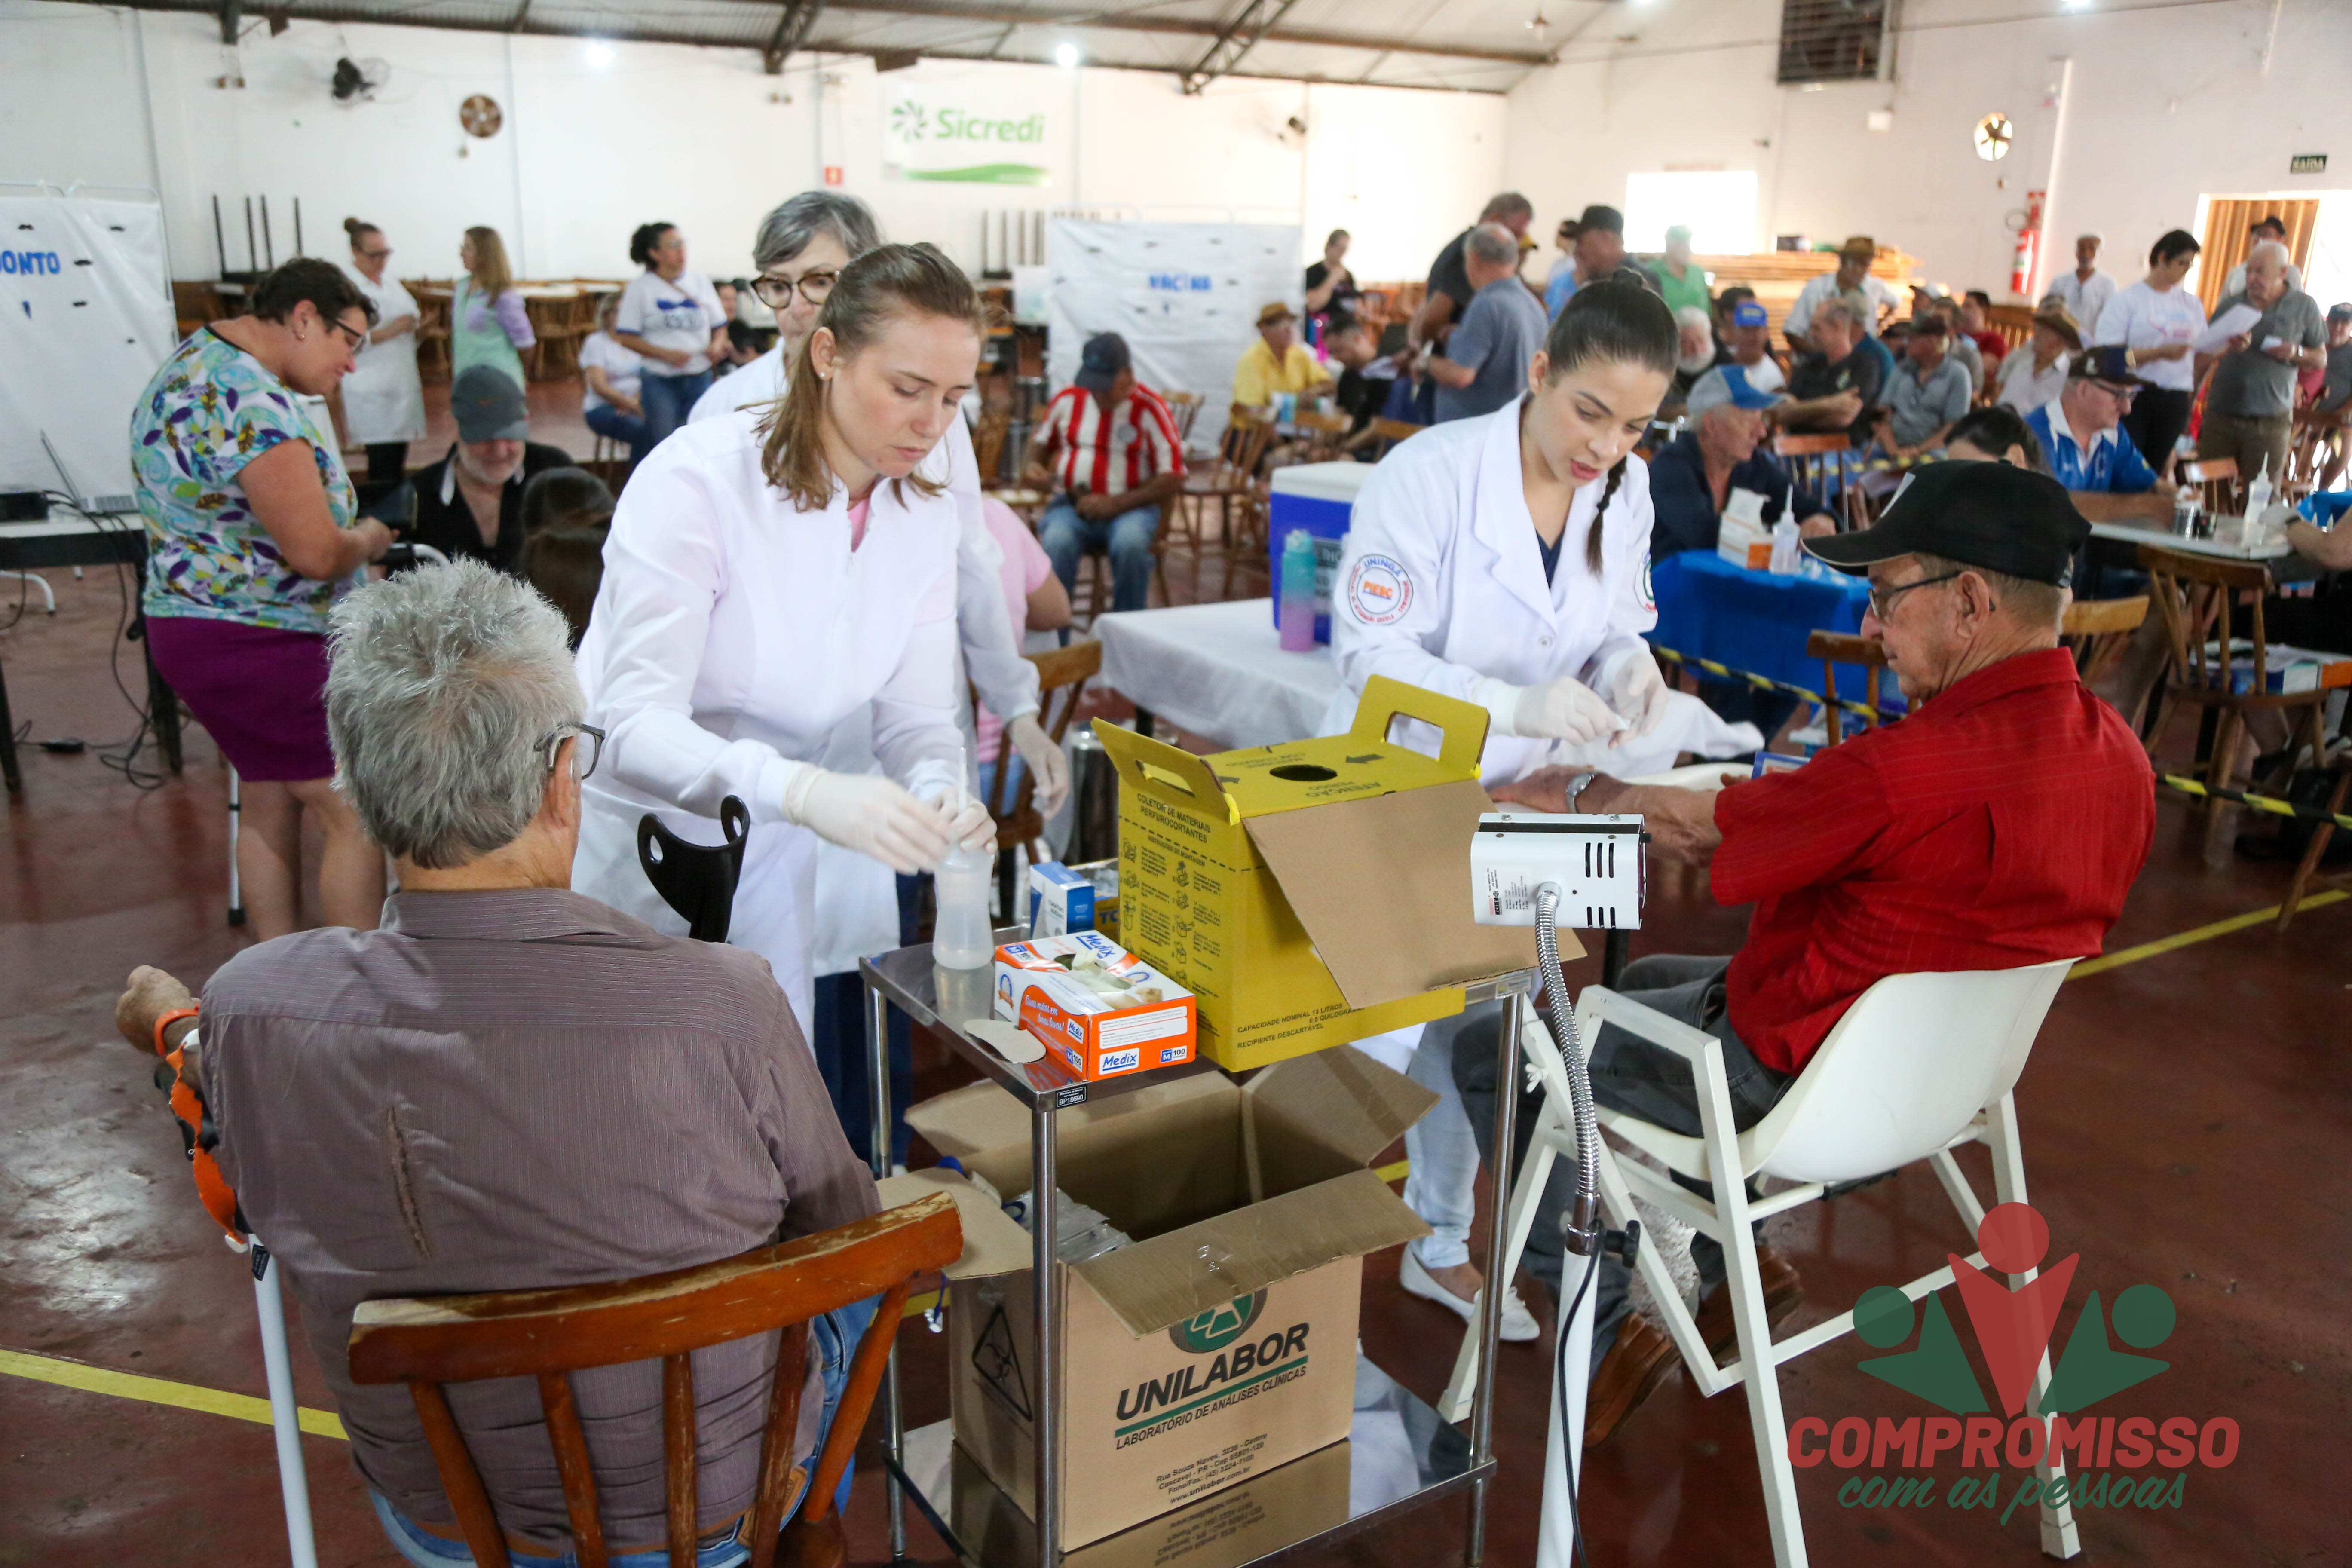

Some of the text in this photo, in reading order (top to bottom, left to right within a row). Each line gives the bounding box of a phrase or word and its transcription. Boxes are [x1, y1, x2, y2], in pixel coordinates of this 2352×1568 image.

[936, 108, 1045, 142] Sicredi
[0, 250, 61, 275] ONTO
[1305, 781, 1381, 797] ATENÇÃO
[1137, 793, 1211, 833] COLETOR DE MATERIAIS
[1141, 805, 1208, 843] PERFUROCORTANTES
[1181, 851, 1205, 867] MONTAGEM
[1080, 934, 1116, 958] Medix
[1050, 1008, 1059, 1016] em
[1237, 1018, 1280, 1033] CAPACIDADE
[1282, 1011, 1311, 1022] NOMINAL
[1320, 1003, 1343, 1013] LITROS
[1069, 1022, 1083, 1036] Medix
[1237, 1023, 1324, 1048] RECIPIENTE DESCARTÁVEL
[1073, 1055, 1082, 1066] 100
[1102, 1053, 1137, 1068] Medix
[1059, 1094, 1084, 1105] BP18690
[1116, 1322, 1310, 1421] UNILABOR
[1116, 1366, 1307, 1450] LABORATÓRIO DE ANÁLISES CLÍNICAS
[1156, 1473, 1171, 1483] Rua
[1173, 1463, 1195, 1476] Souza
[1196, 1454, 1220, 1466] Naves,
[1244, 1433, 1267, 1446] Centro
[1159, 1471, 1192, 1489] Cascavel
[1198, 1465, 1208, 1474] PR
[1214, 1458, 1228, 1467] Cep
[1169, 1476, 1204, 1494] Fone/Fax:
[1206, 1469, 1219, 1480] (45)
[1170, 1466, 1252, 1503] www.unilabor.com.br
